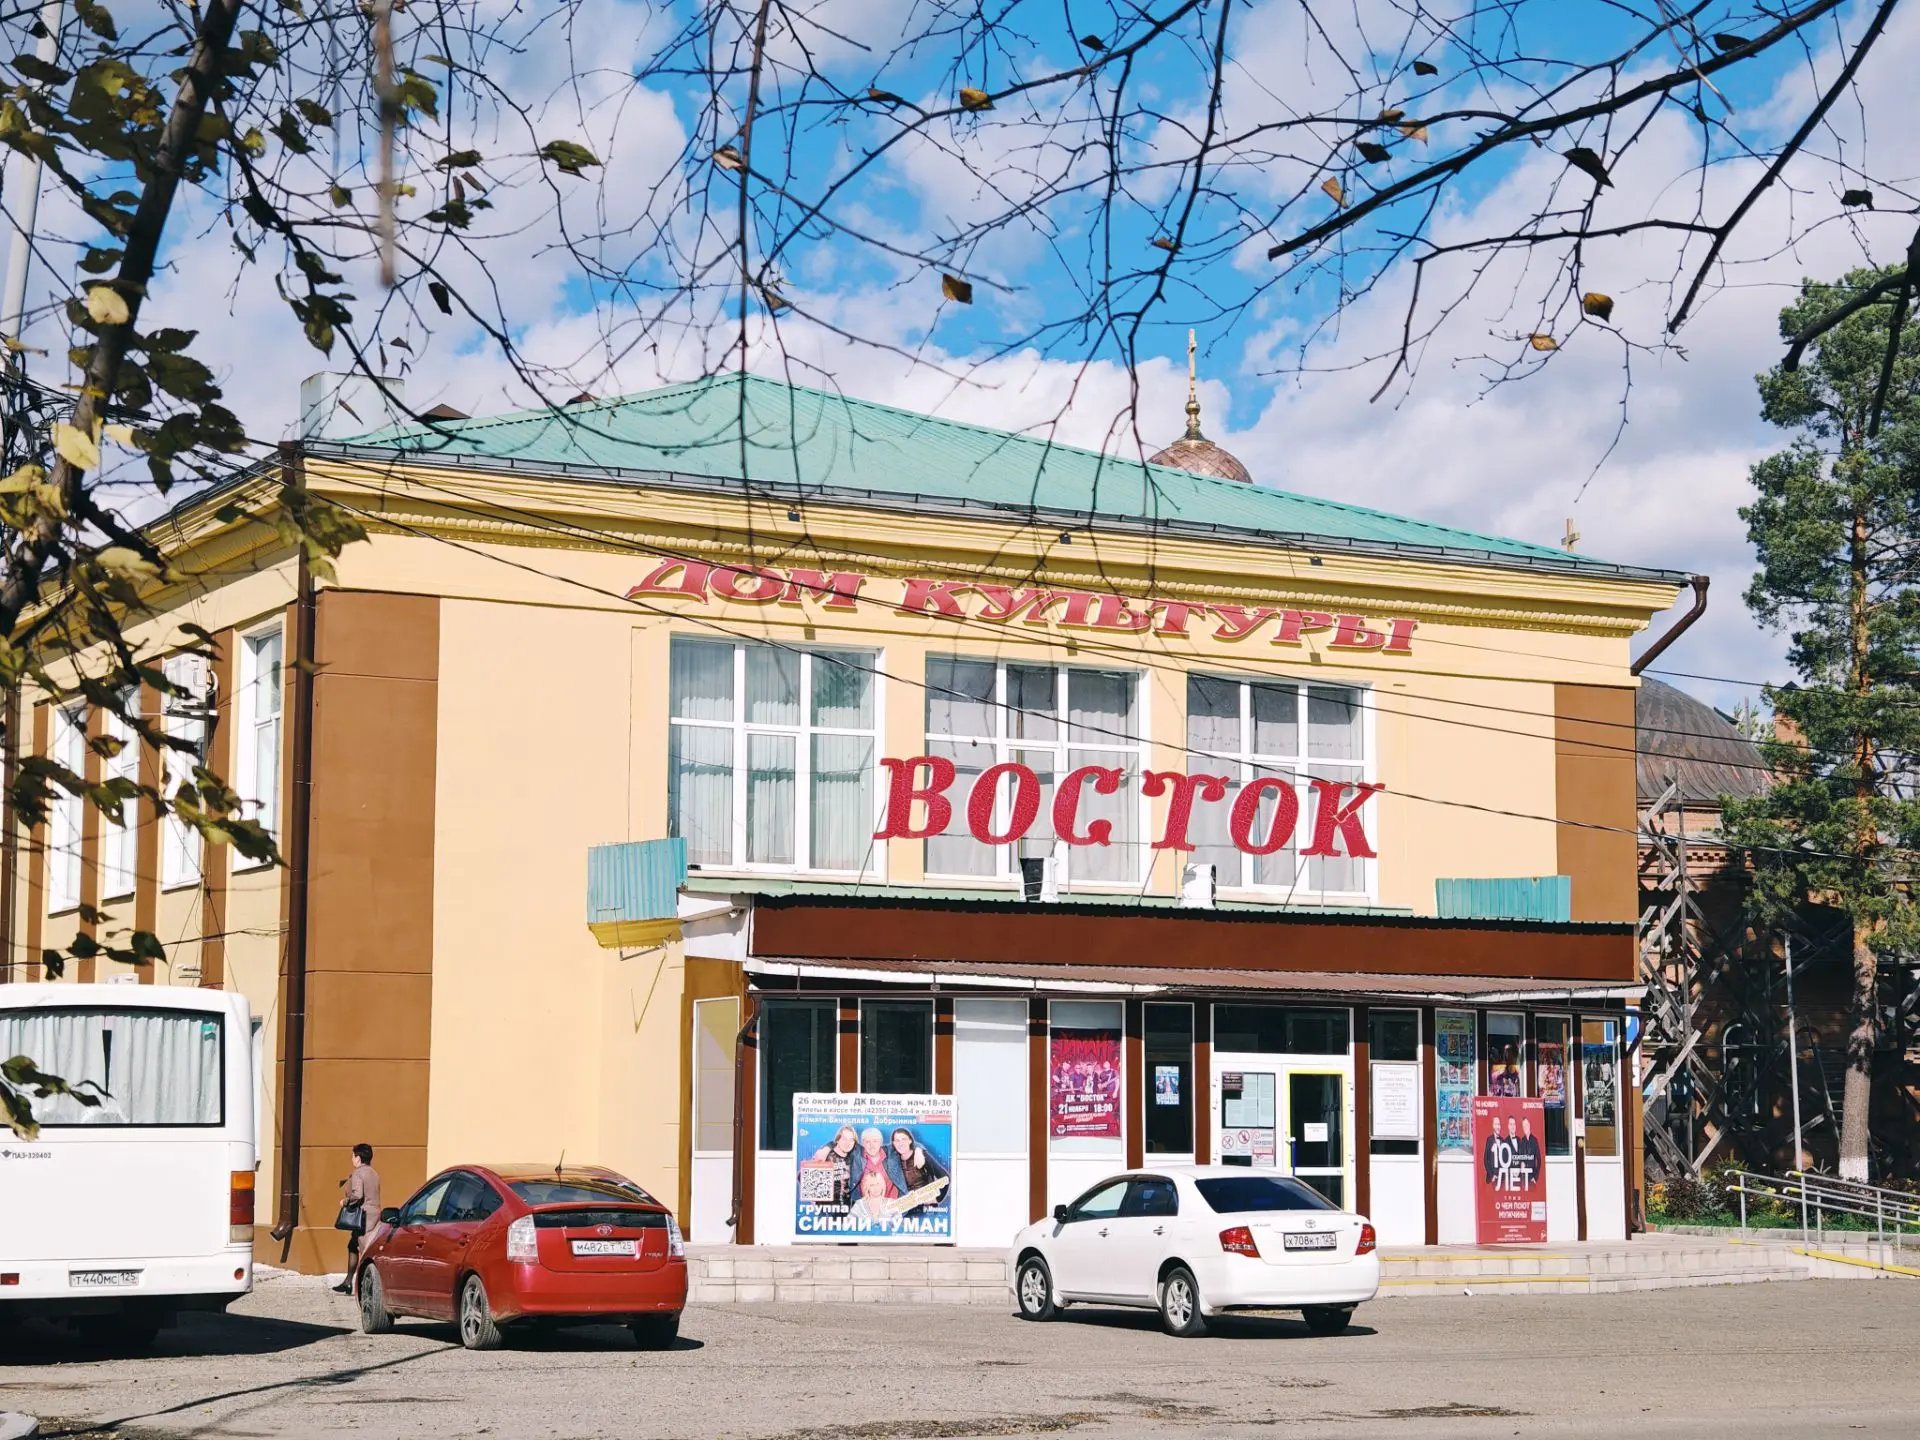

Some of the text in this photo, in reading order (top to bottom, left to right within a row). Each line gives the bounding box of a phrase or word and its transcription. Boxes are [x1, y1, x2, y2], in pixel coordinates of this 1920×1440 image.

[624, 557, 1418, 652] ДОМ КУЛЬТУРЫ
[872, 755, 1386, 859] ВОСТОК
[798, 1097, 809, 1105] 26
[812, 1098, 848, 1107] октября
[854, 1098, 867, 1106] ДК
[870, 1098, 902, 1106] Восток
[1491, 1142, 1512, 1168] 10
[1495, 1167, 1533, 1191] ЛЕТ
[799, 1204, 849, 1216] группа
[878, 1216, 949, 1233] ТУМАН
[75, 1272, 136, 1285] Т440МС 125
